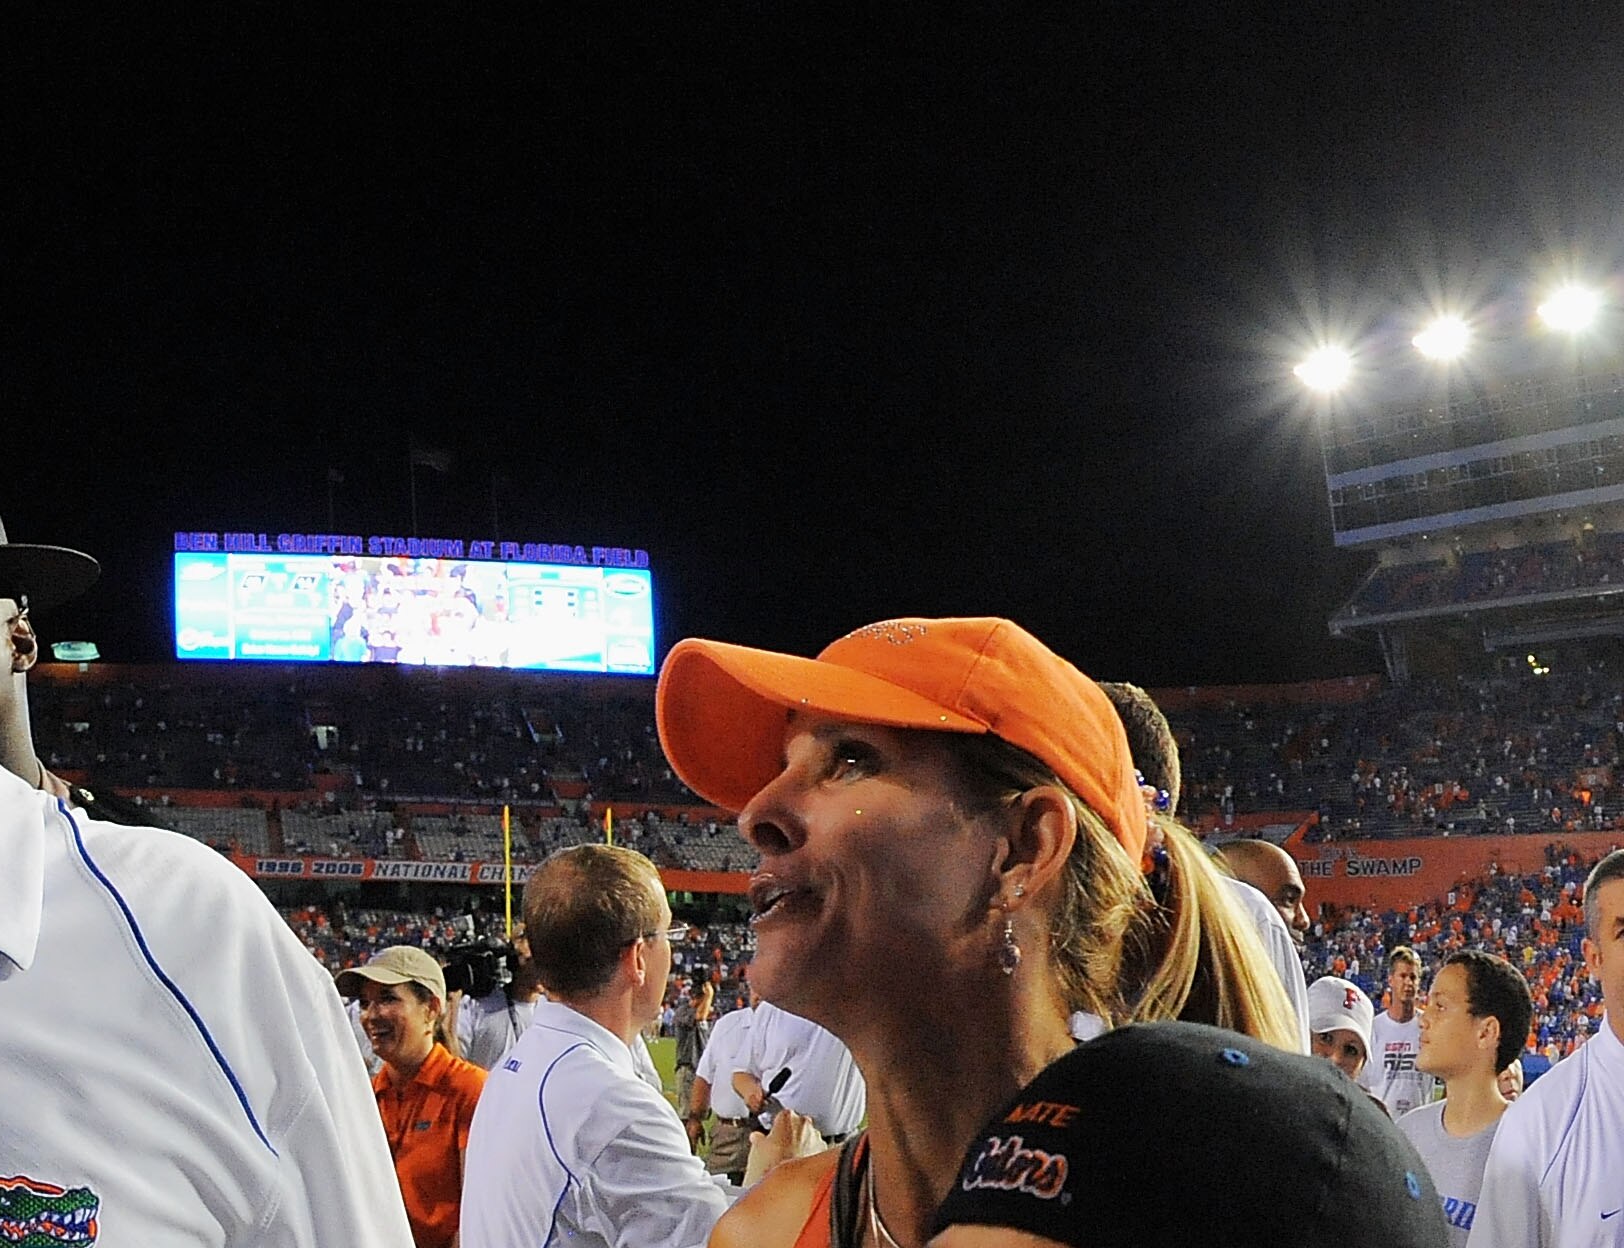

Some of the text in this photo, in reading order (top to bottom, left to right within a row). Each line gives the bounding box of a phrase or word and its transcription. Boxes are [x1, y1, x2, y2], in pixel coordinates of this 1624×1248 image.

[175, 532, 649, 568] BEN HILL GRIFFIN STADIUM AT FLORIDA FIELD
[257, 860, 303, 874] 1996
[312, 861, 364, 876] 2006
[375, 862, 471, 880] NATIONAL
[1300, 857, 1423, 877] THE SWAMP
